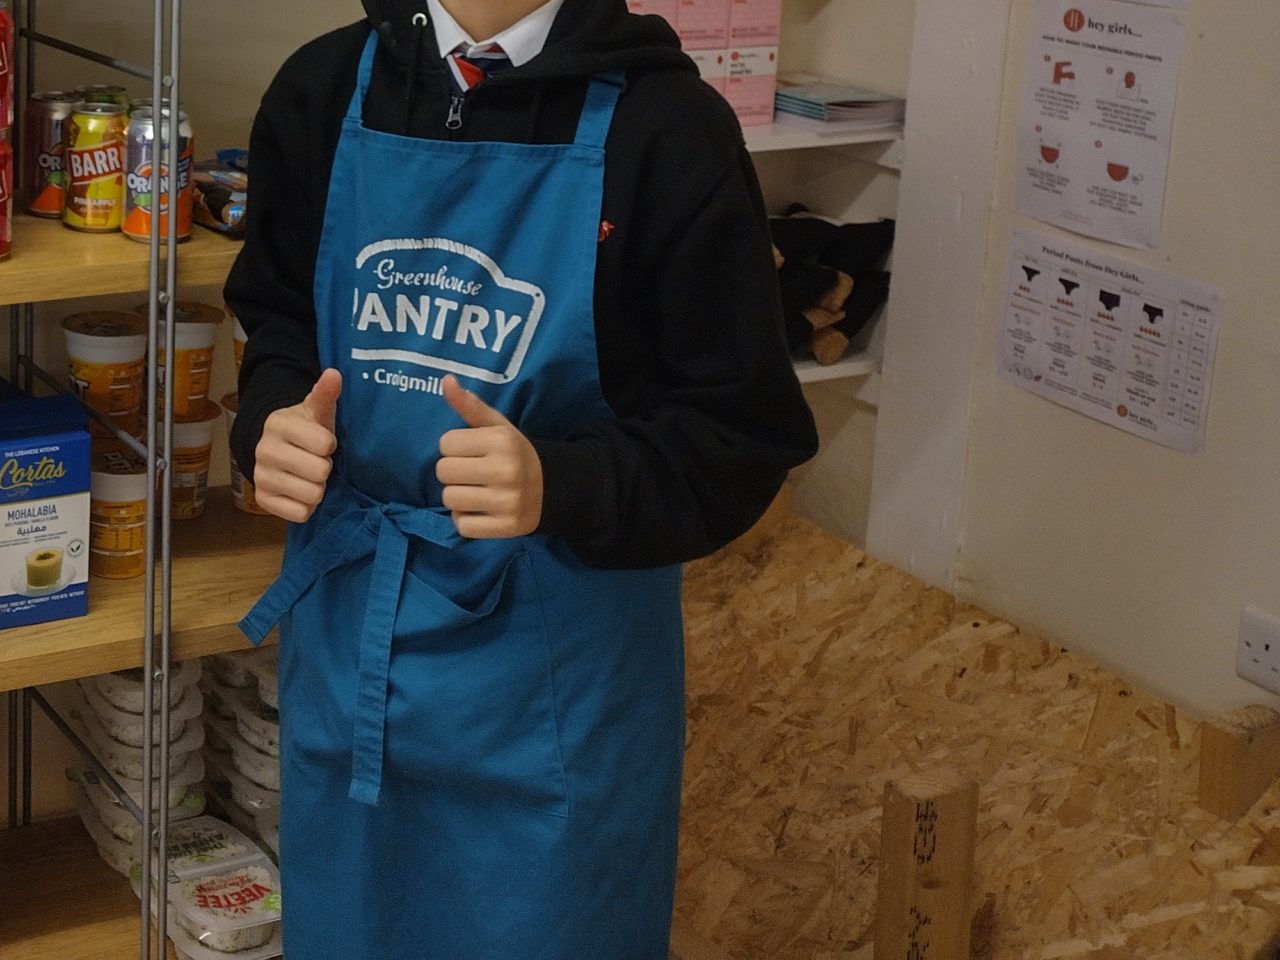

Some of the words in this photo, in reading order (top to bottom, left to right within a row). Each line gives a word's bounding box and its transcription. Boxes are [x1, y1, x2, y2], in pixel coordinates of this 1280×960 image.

[1087, 18, 1105, 32] hey
[71, 147, 120, 178] BARR
[373, 257, 482, 296] Greenhouse
[351, 288, 522, 354] ANTRY
[374, 368, 444, 396] Craigmill
[7, 504, 58, 521] MOHALABIA
